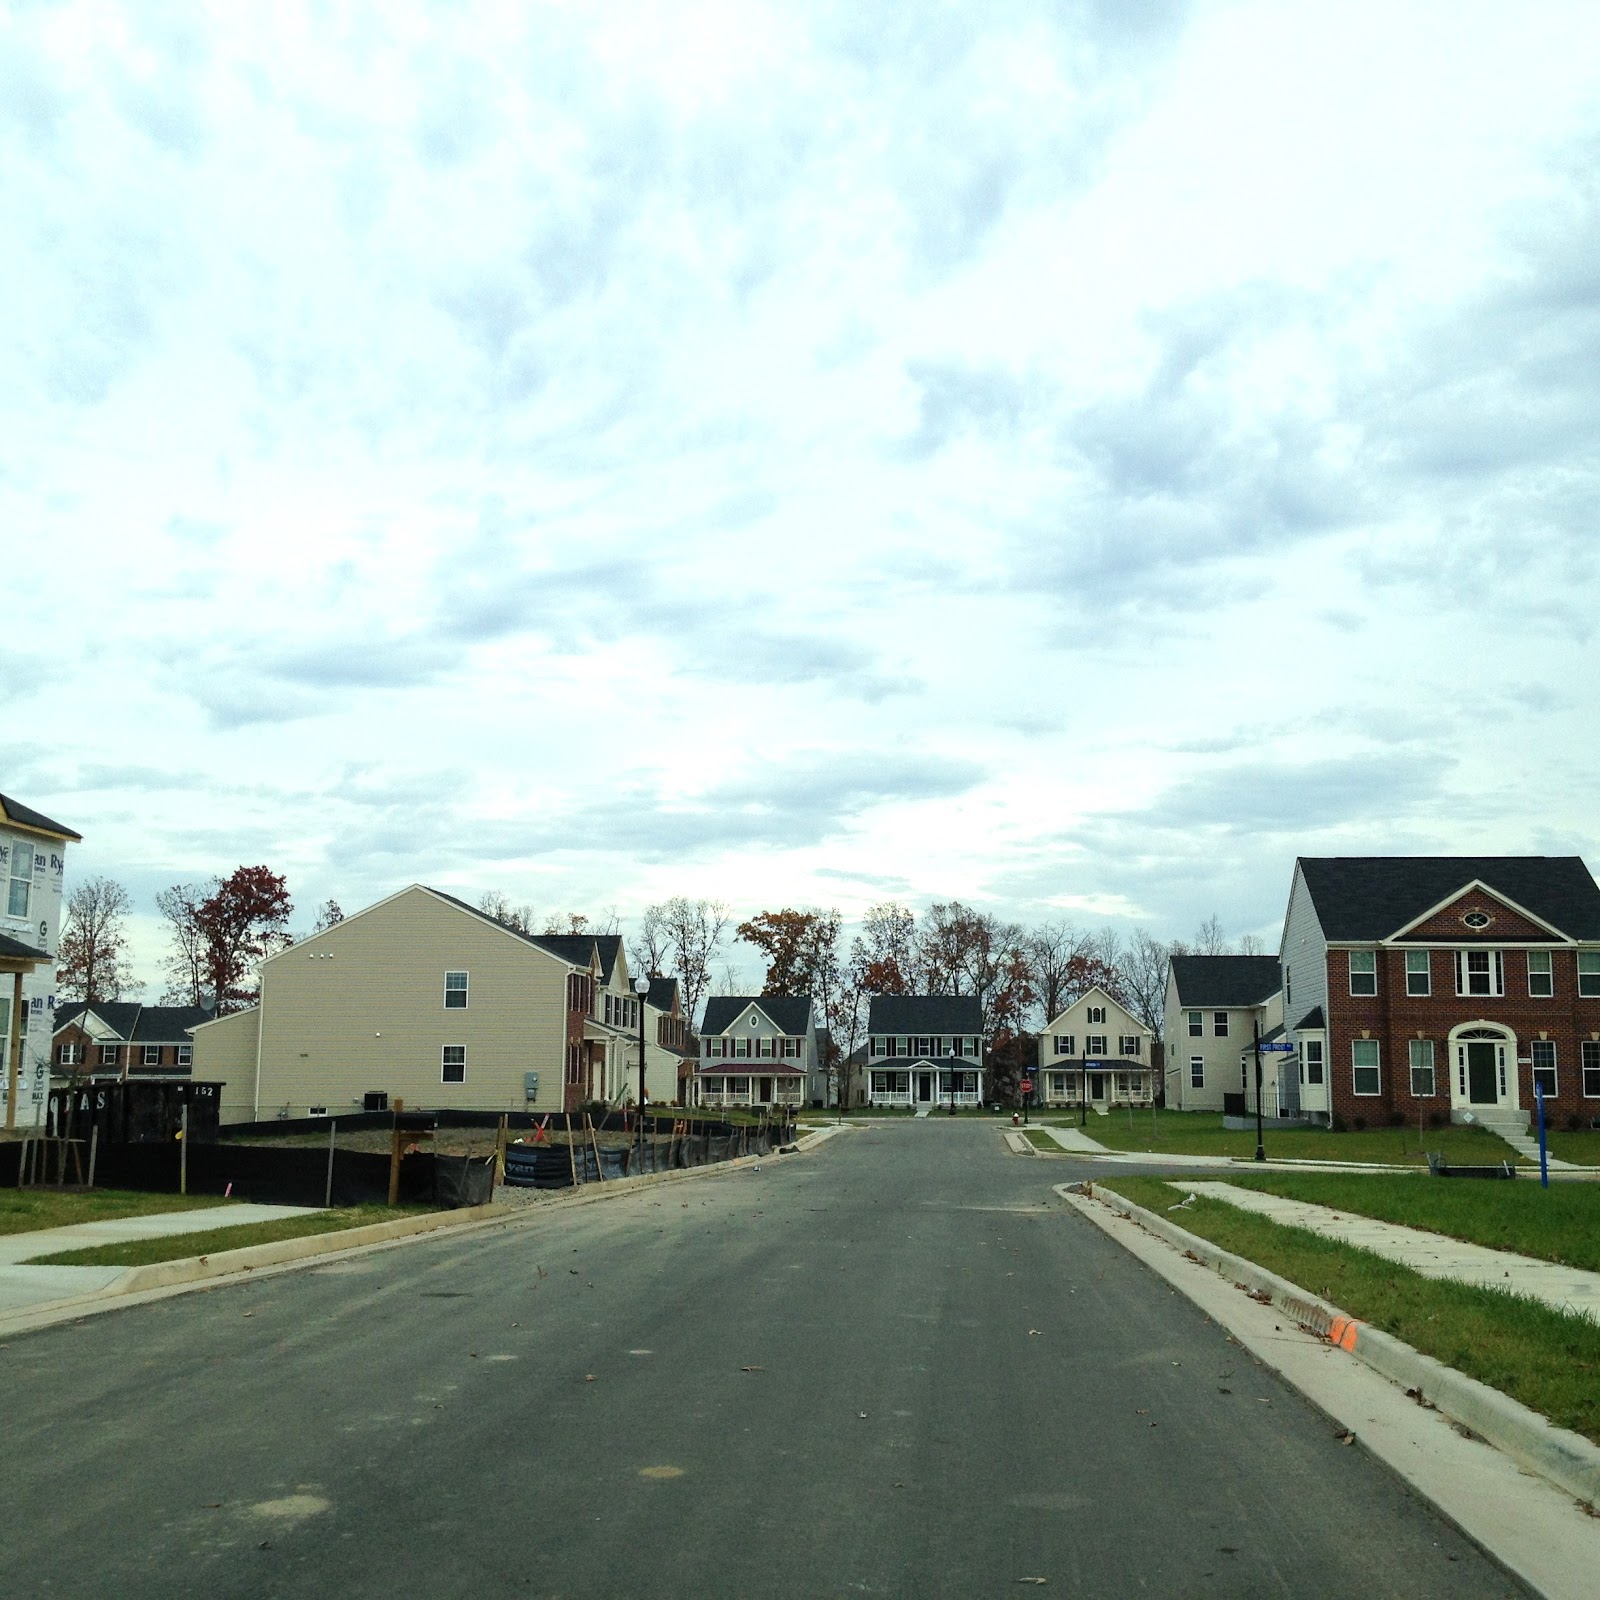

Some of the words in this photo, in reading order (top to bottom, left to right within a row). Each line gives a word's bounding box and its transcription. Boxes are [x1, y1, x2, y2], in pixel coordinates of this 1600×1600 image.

[35, 854, 46, 866] an
[50, 853, 64, 876] Ry
[39, 920, 48, 937] G
[31, 997, 43, 1009] an
[195, 1086, 214, 1097] 152
[507, 1161, 535, 1174] yan
